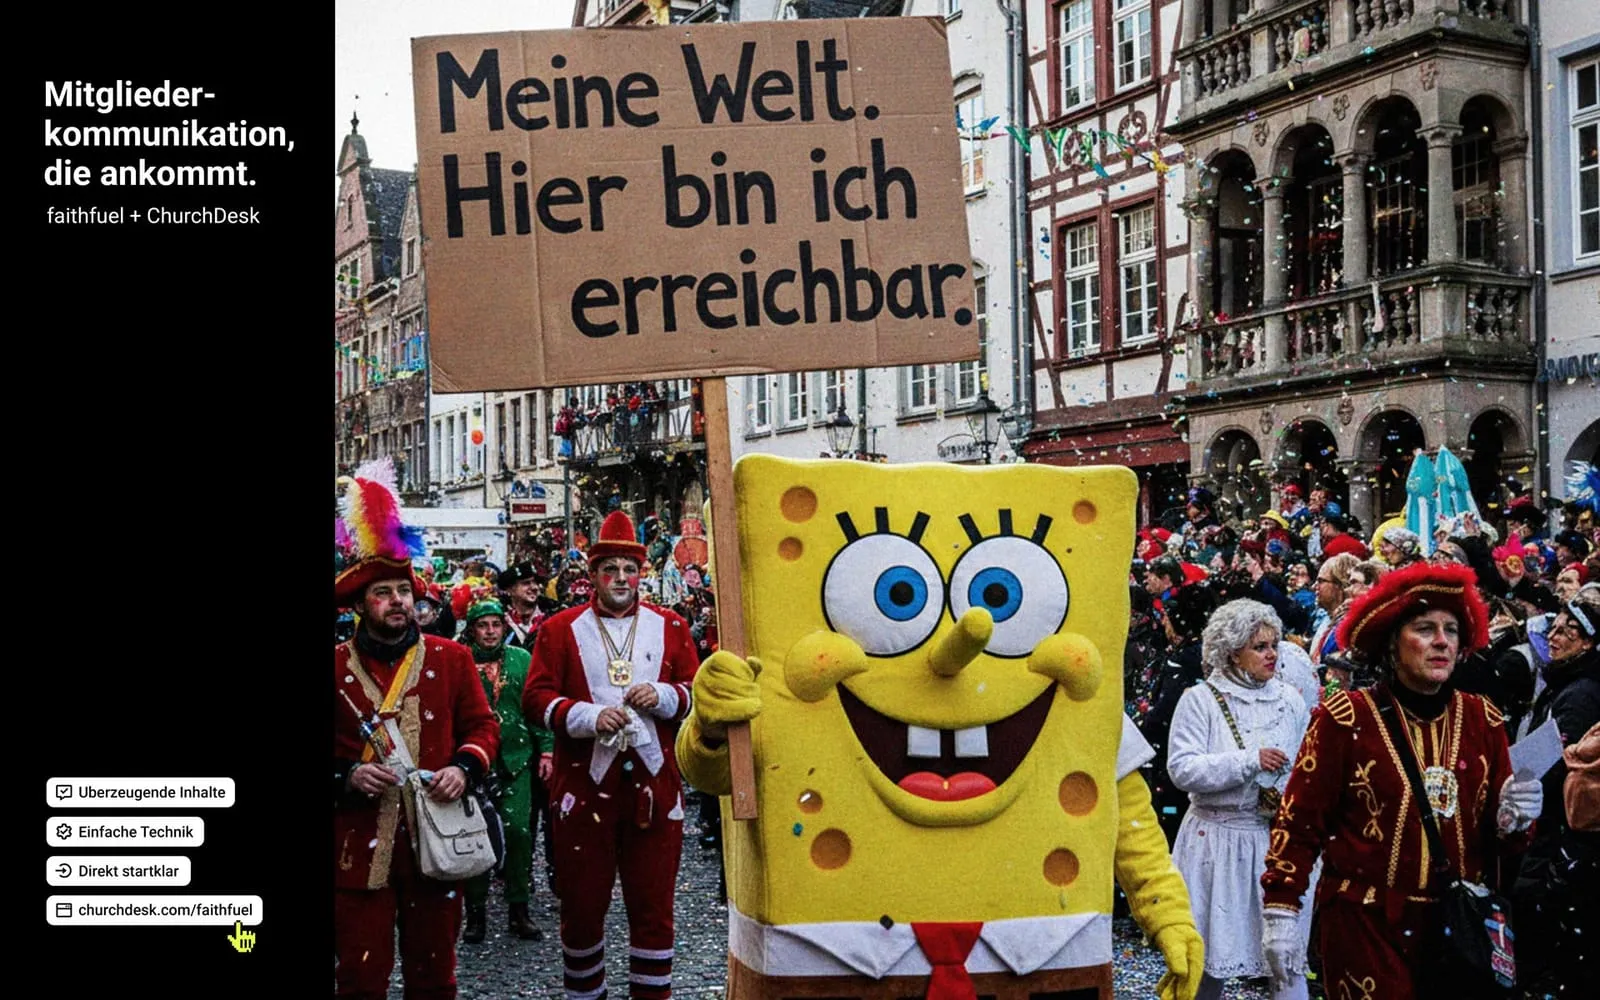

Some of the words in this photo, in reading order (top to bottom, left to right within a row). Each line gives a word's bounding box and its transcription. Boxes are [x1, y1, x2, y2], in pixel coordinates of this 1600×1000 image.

[436, 48, 660, 133] Meine
[681, 38, 880, 124] Welt.
[443, 151, 628, 238] Hier
[661, 144, 777, 229] bin
[809, 137, 917, 222] ich
[571, 238, 973, 338] erreichbar.
